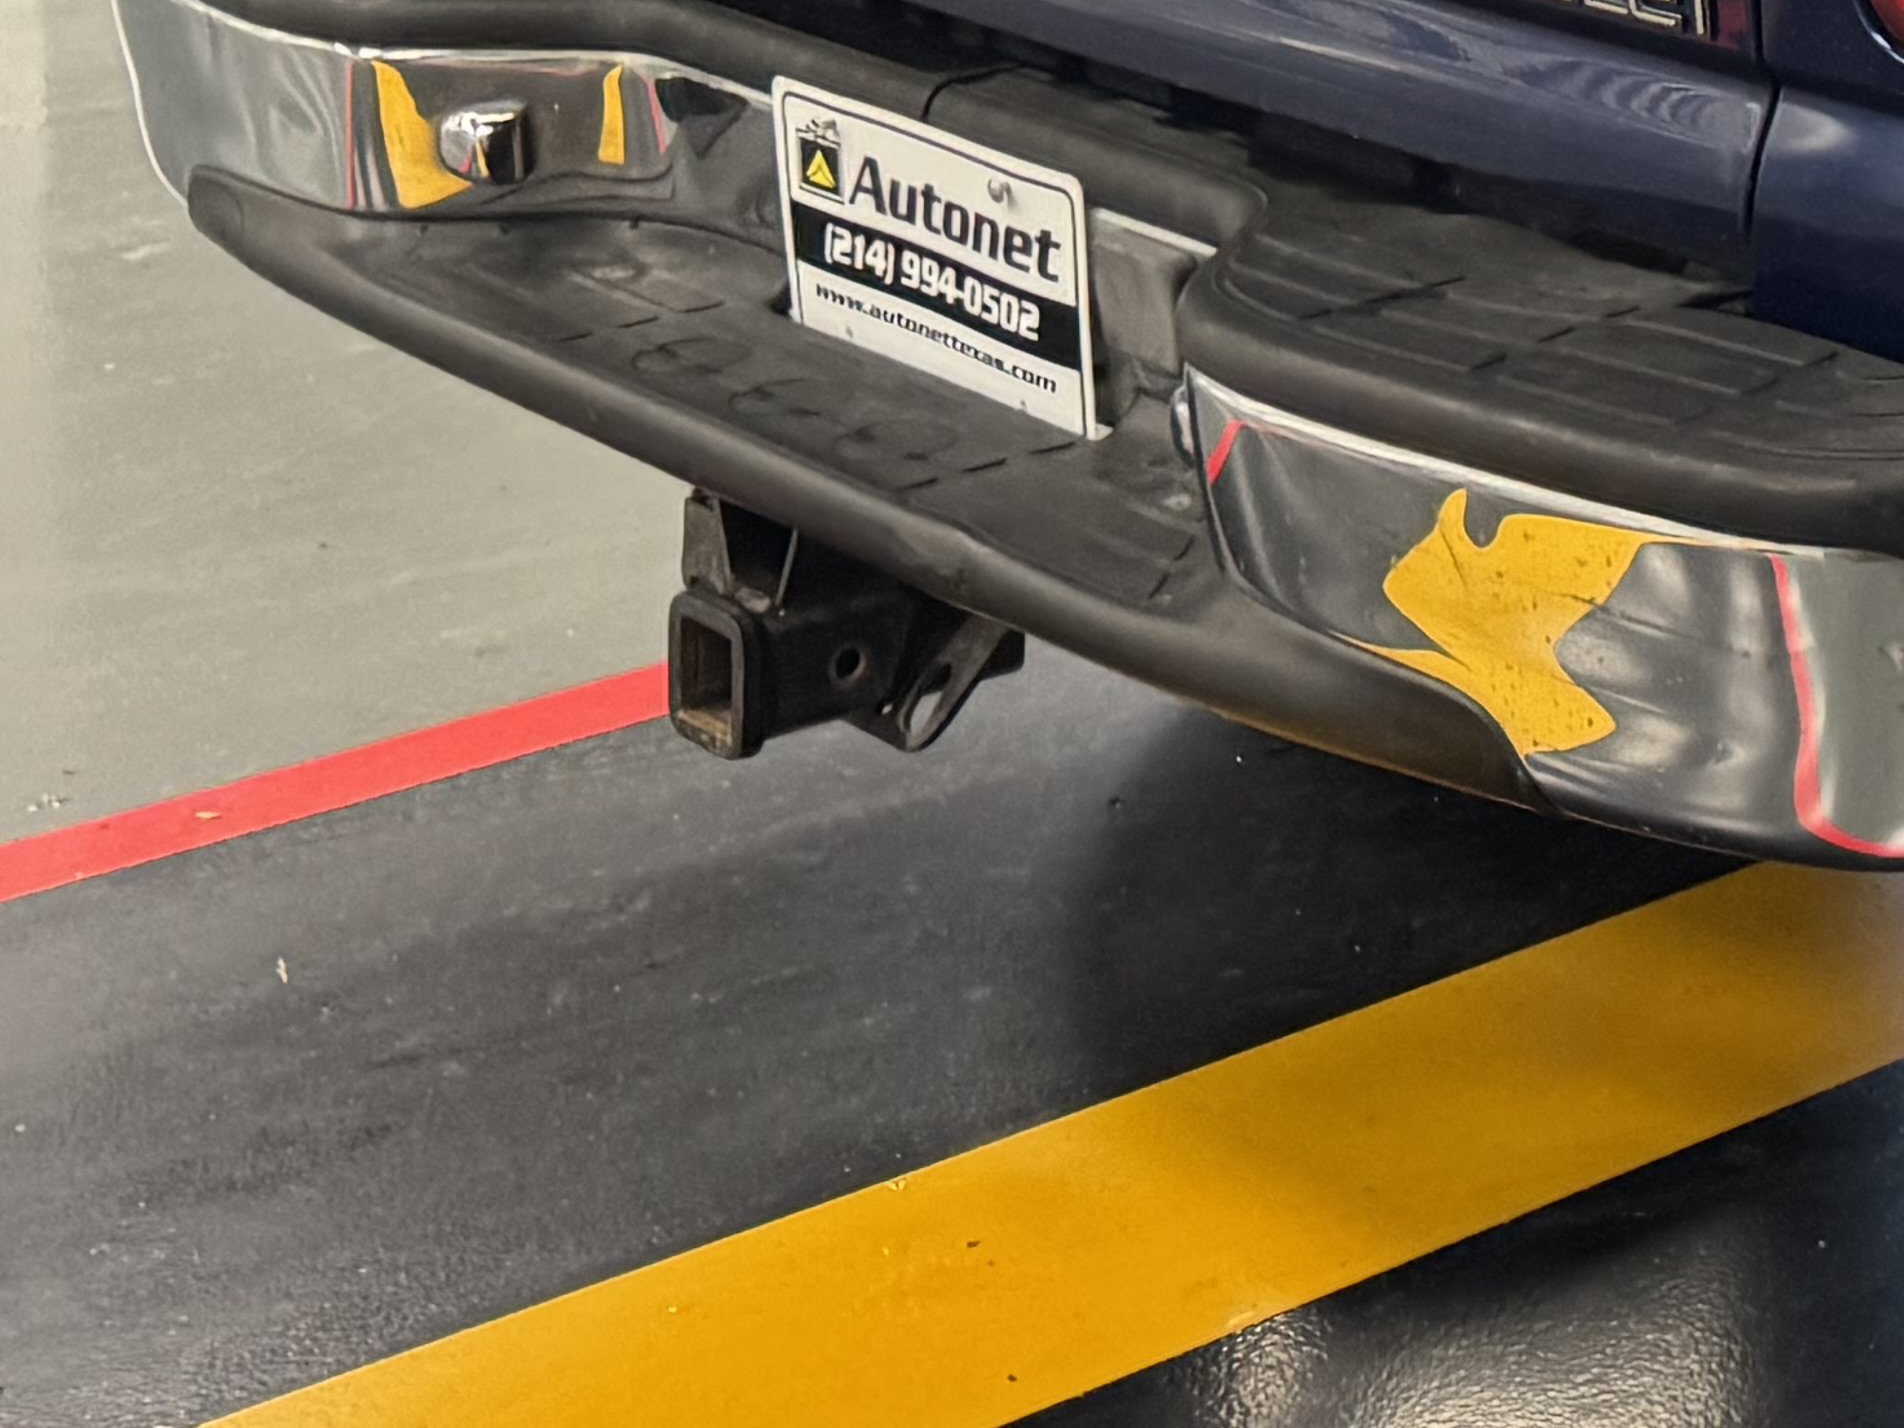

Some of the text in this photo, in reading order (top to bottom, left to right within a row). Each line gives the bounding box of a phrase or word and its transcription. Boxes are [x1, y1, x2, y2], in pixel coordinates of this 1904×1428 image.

[848, 155, 1061, 284] Autonet
[815, 282, 1057, 394] www.autonettexas.com
[823, 221, 1041, 342] (214) 994-0502
